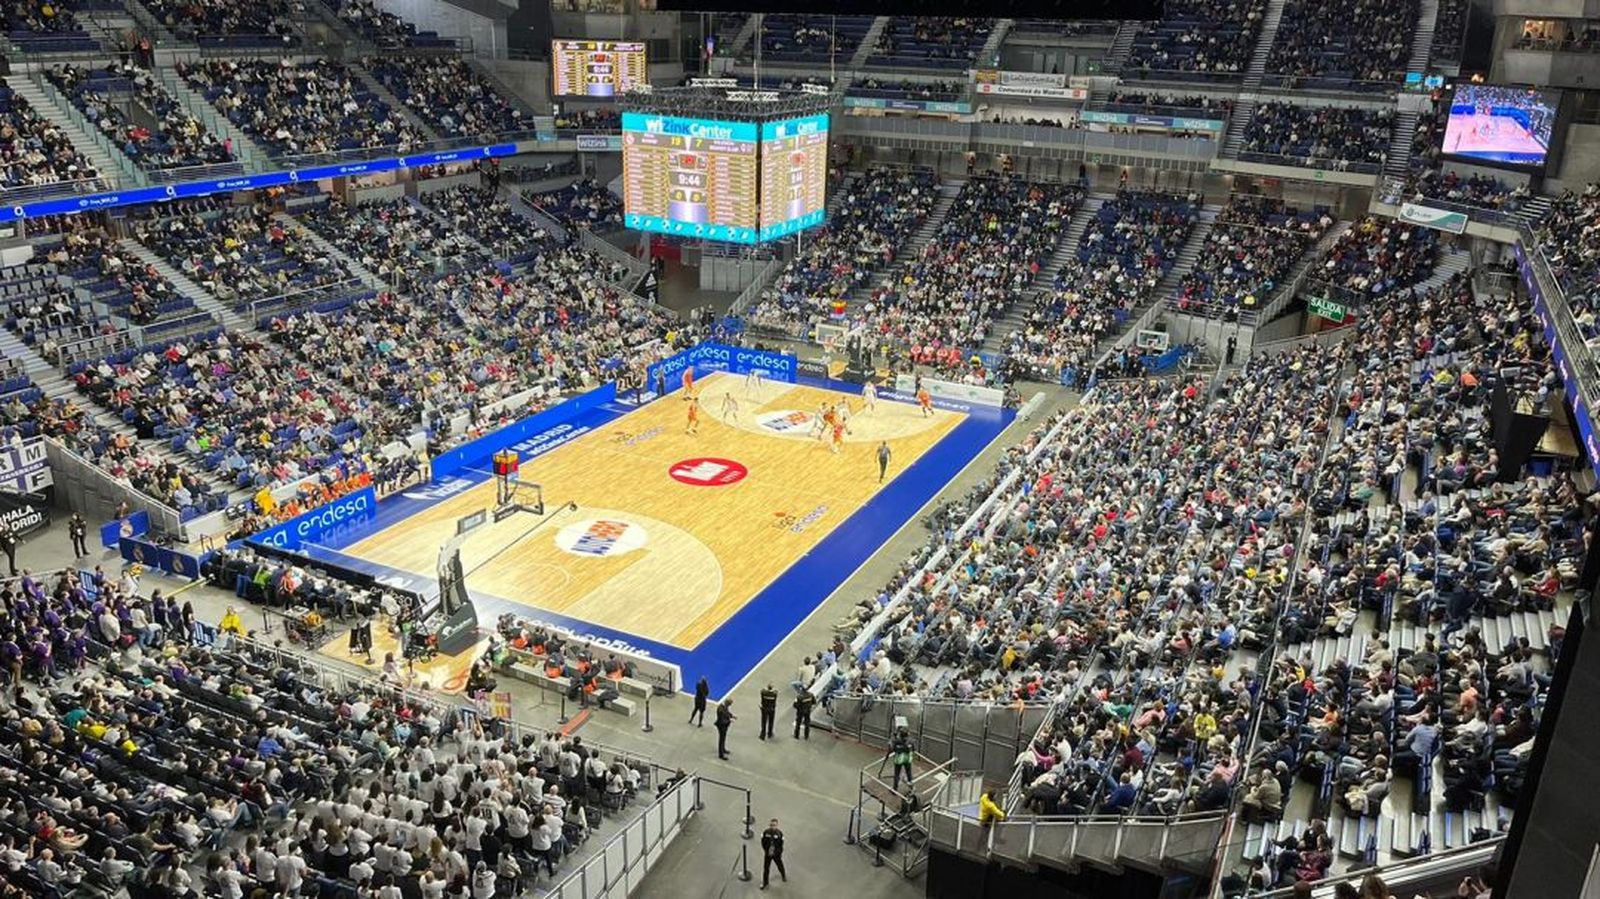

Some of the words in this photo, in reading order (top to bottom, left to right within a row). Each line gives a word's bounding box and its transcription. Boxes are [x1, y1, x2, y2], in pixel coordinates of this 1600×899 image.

[1310, 297, 1342, 314] SALIDA
[689, 345, 730, 363] endesa
[737, 352, 789, 370] endesa
[511, 424, 573, 451] MADRID
[297, 495, 367, 536] endesa
